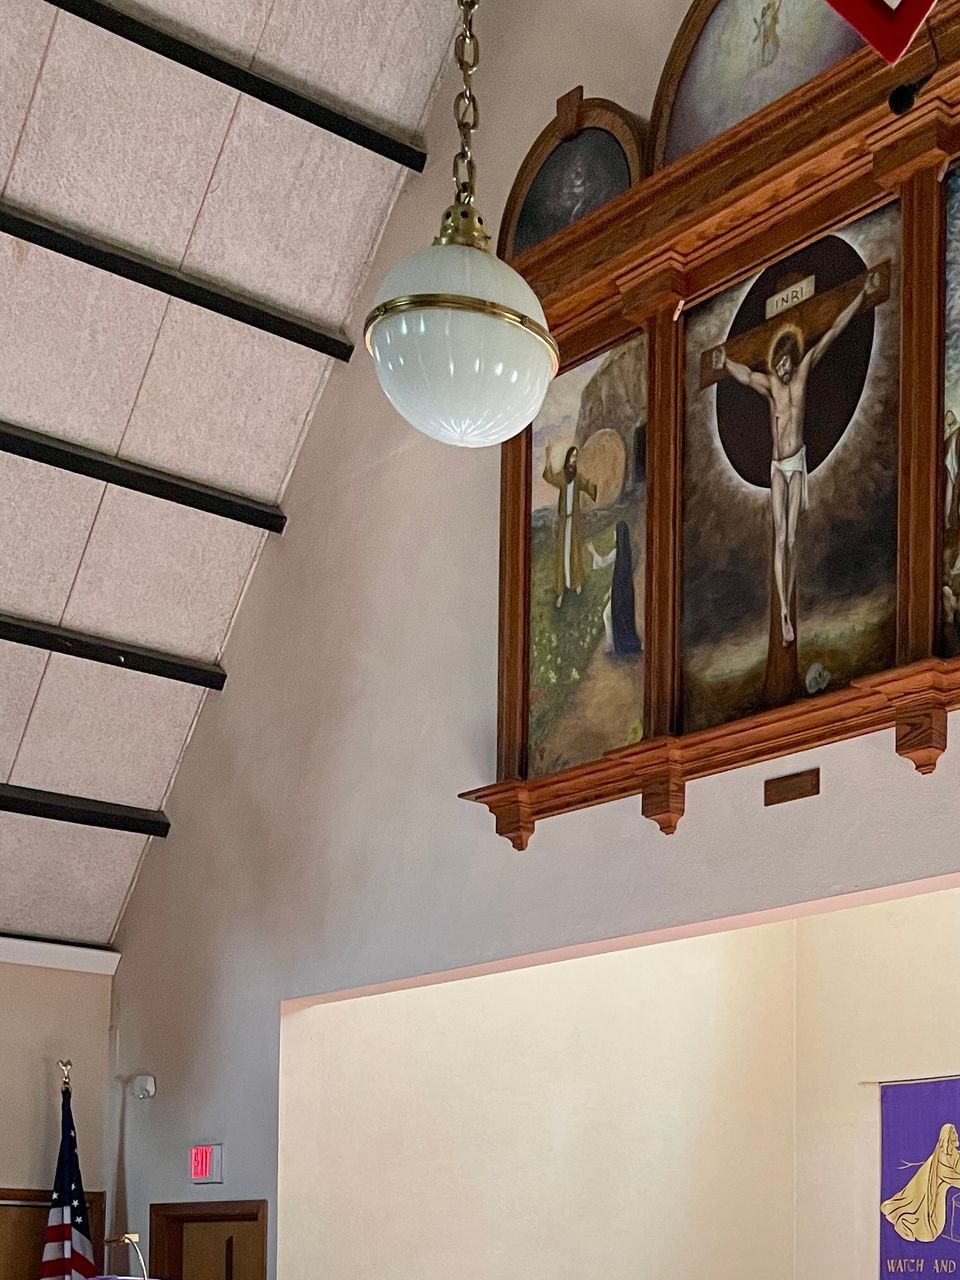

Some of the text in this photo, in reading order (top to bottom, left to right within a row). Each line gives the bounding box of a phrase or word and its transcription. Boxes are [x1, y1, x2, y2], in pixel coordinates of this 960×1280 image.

[775, 286, 804, 310] INRI
[191, 1146, 212, 1179] EXIT
[887, 1258, 924, 1273] WATCH
[933, 1258, 956, 1273] AND
